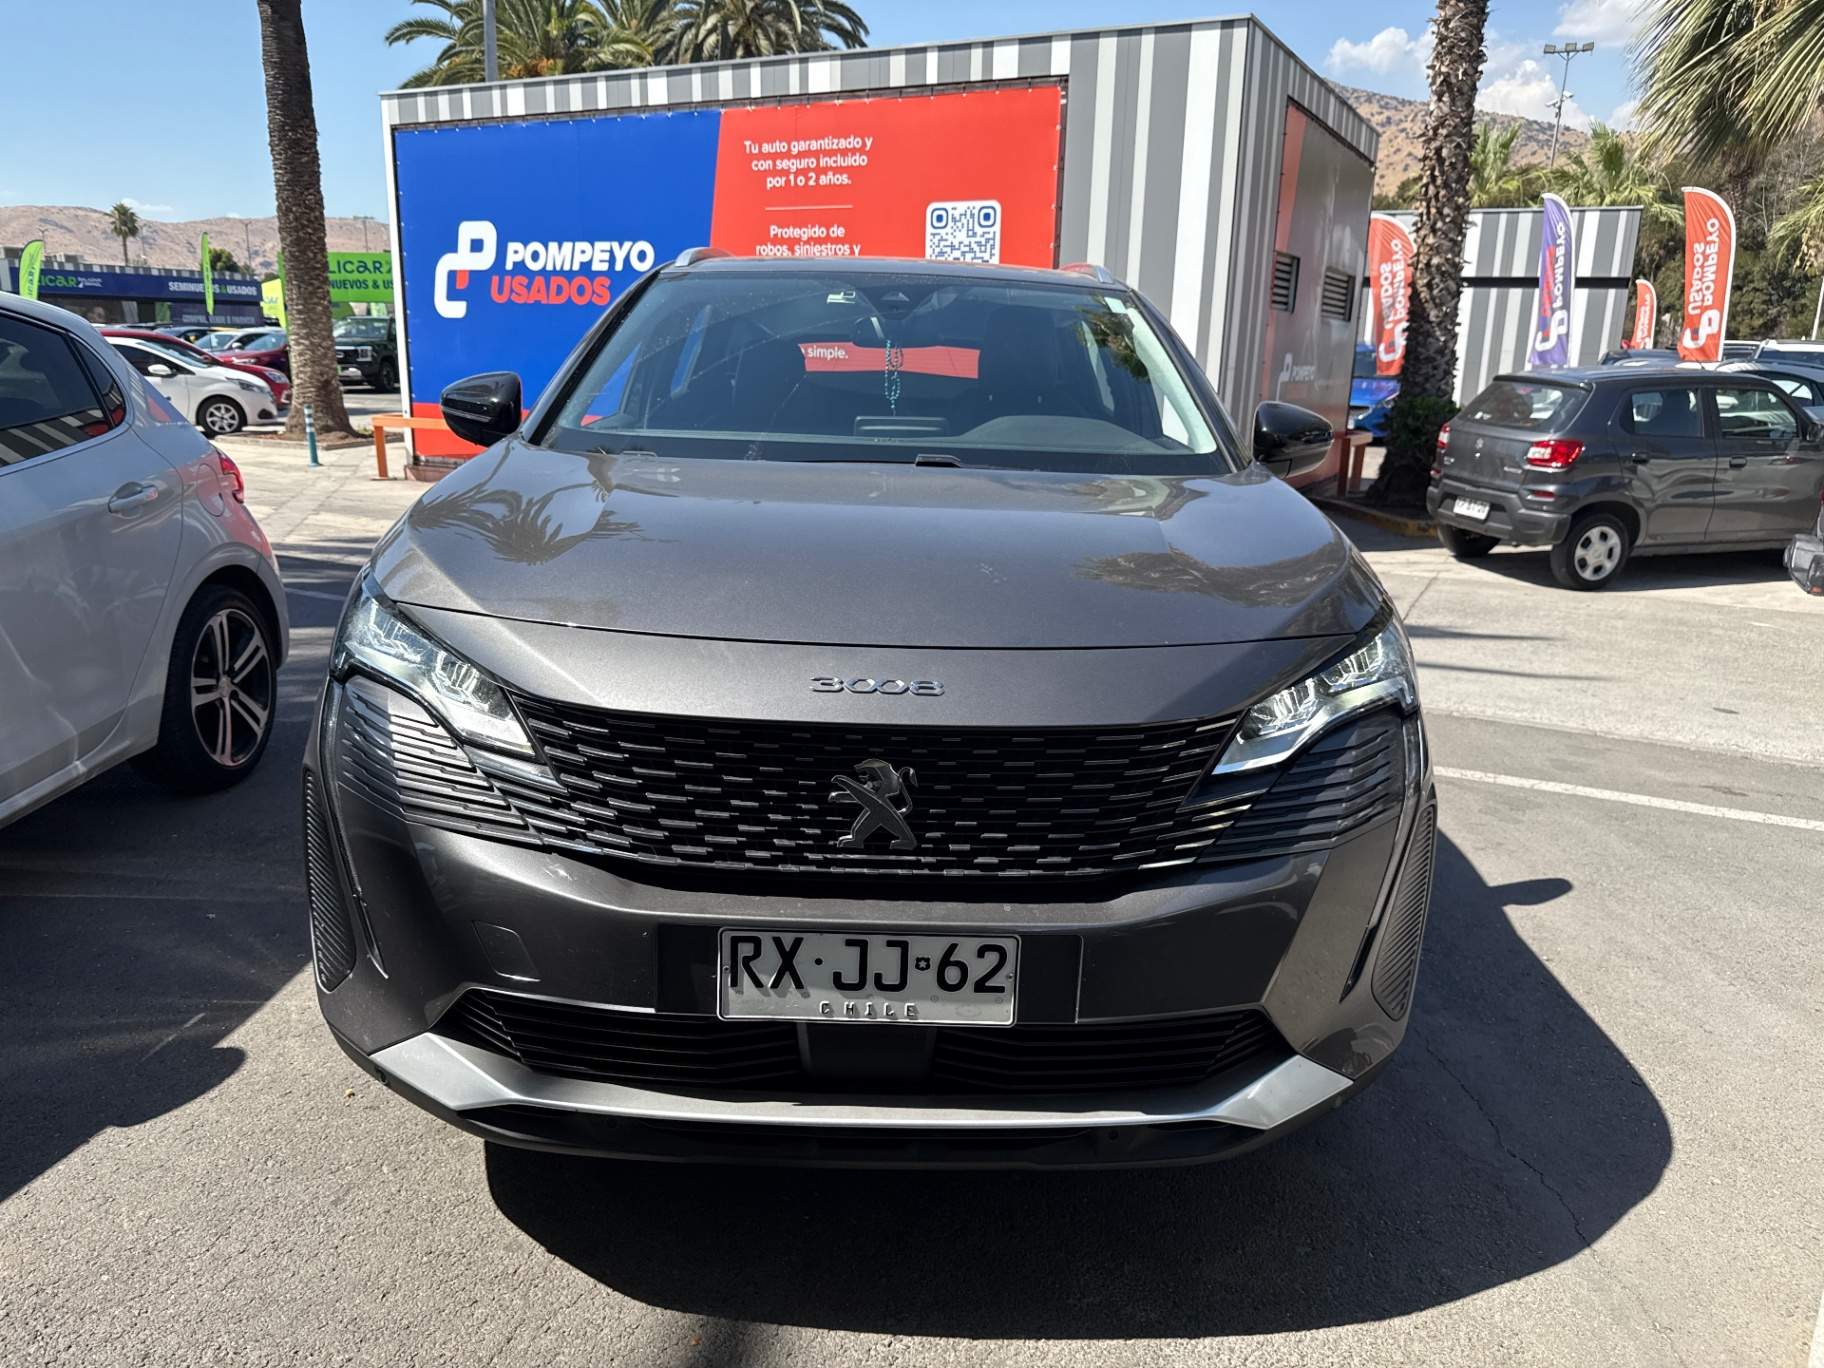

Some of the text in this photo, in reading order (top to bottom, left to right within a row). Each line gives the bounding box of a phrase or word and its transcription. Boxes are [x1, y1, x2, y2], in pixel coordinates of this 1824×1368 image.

[743, 134, 874, 156] Tu auto garantizado y
[751, 153, 869, 174] con seguro incluido
[766, 170, 852, 191] por 1 o 2 años.
[769, 222, 846, 241] Protegido de
[505, 240, 655, 273] POMPEYO
[755, 242, 793, 257] robos,
[793, 242, 851, 257] siniestros
[227, 284, 257, 296] USADOS
[490, 275, 611, 306] USADOS
[806, 344, 849, 361] simple.
[808, 675, 946, 697] 3008
[818, 1000, 921, 1019] CHILE
